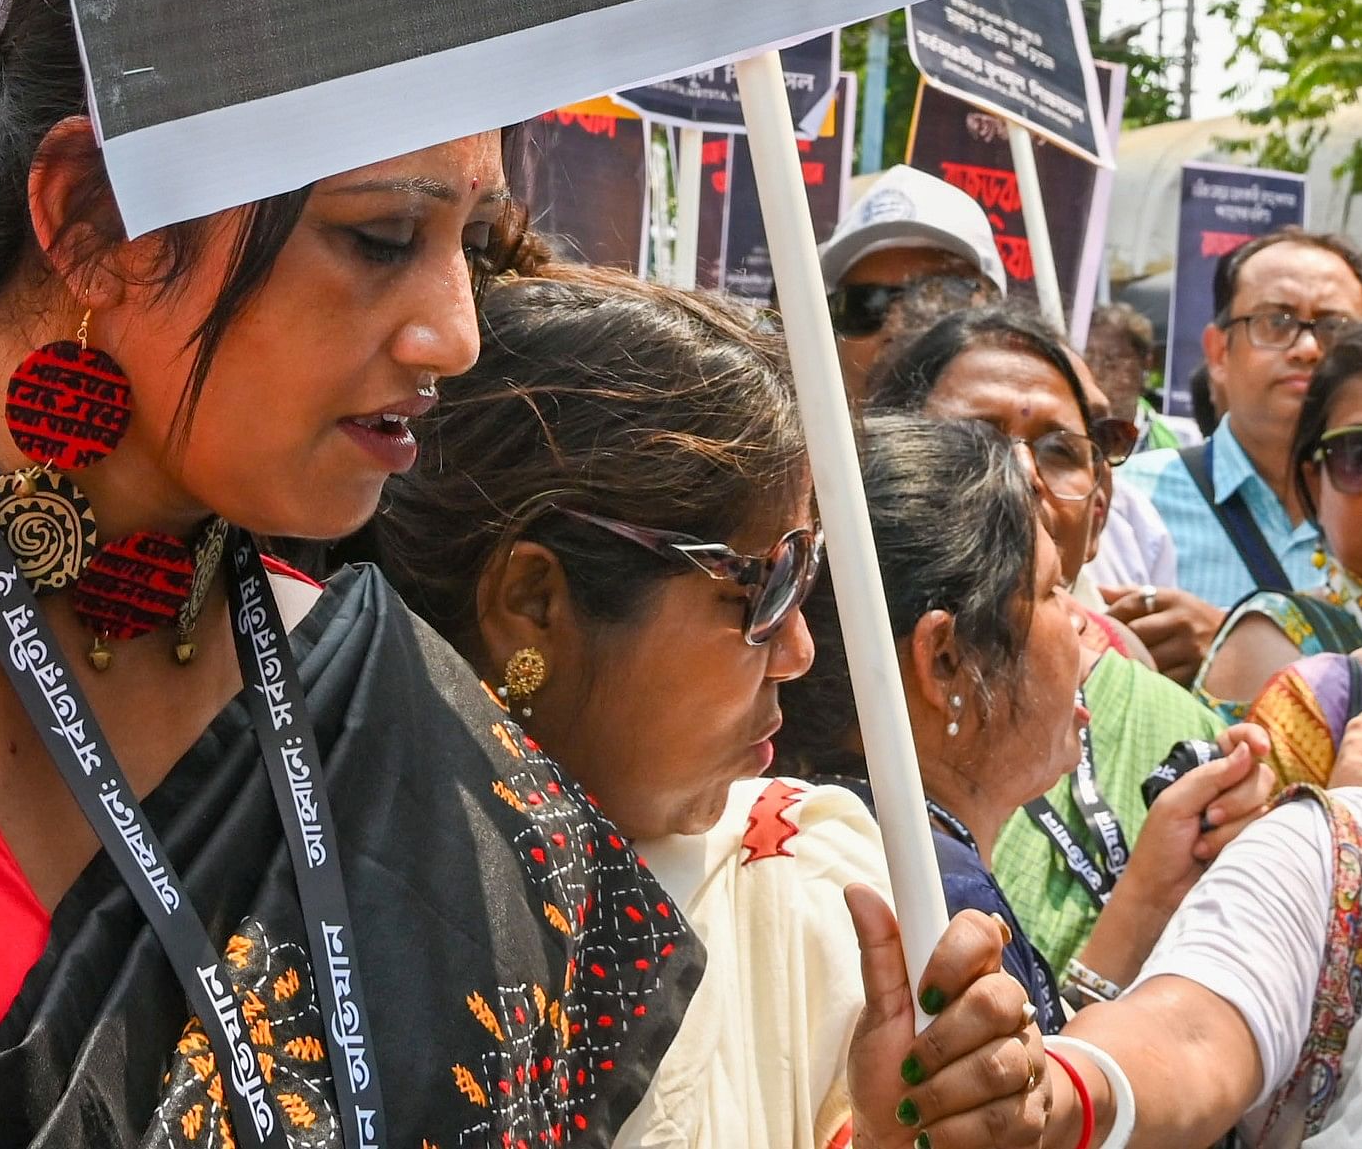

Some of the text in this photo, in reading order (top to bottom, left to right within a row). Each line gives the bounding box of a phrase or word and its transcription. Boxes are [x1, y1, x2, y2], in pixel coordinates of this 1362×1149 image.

[2, 603, 102, 778] সর্বভারতীয়
[239, 577, 295, 732] সর্বভারতীয়
[195, 963, 276, 1144] অভিযান
[320, 920, 374, 1095] অভিযান
